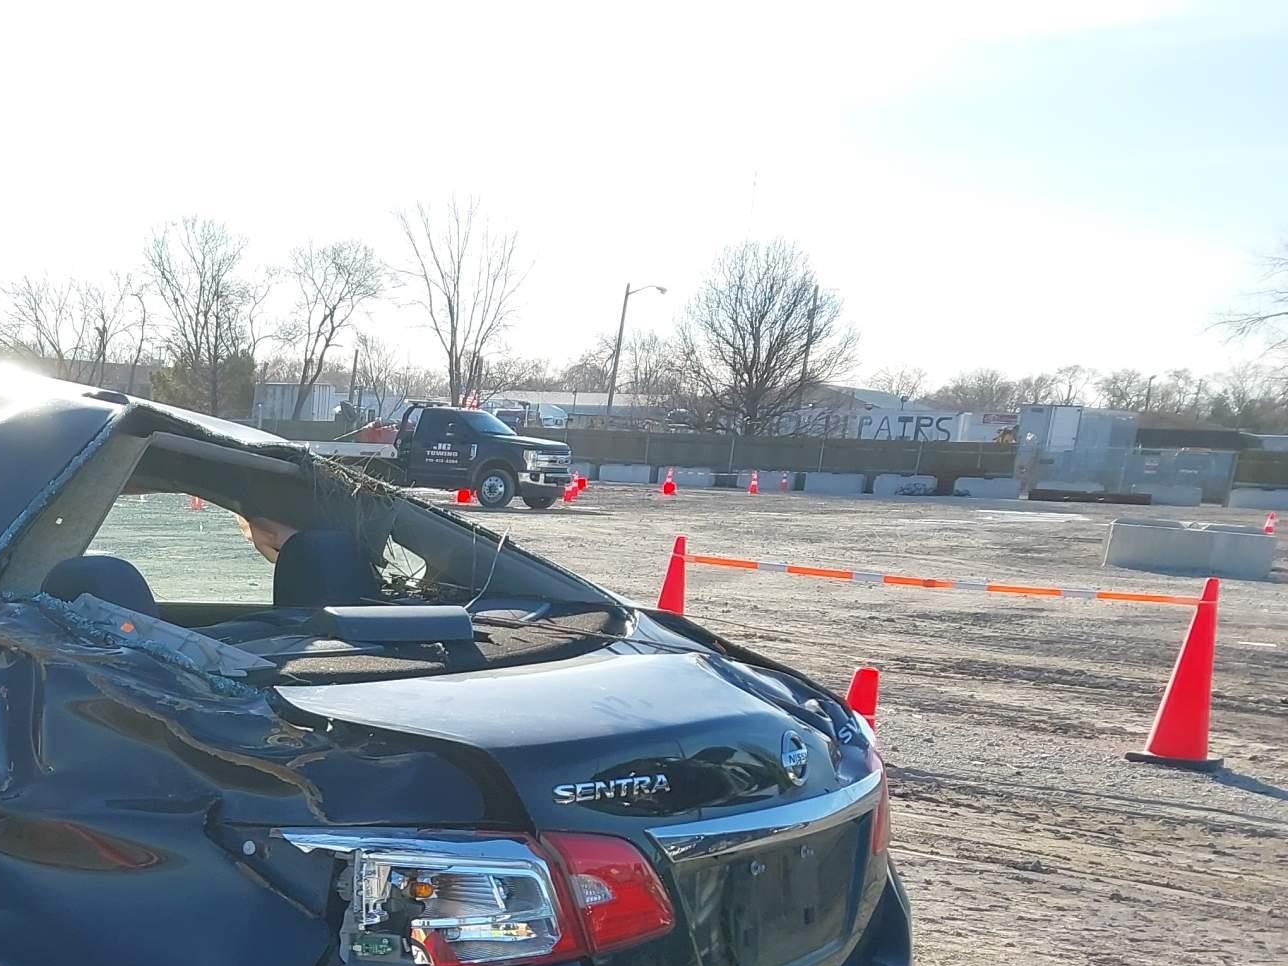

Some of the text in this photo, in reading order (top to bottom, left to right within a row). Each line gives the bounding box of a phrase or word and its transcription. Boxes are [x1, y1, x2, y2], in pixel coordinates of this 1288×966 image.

[824, 414, 953, 442] PAIRS
[838, 716, 859, 744] SV
[552, 774, 671, 804] SENTRA
